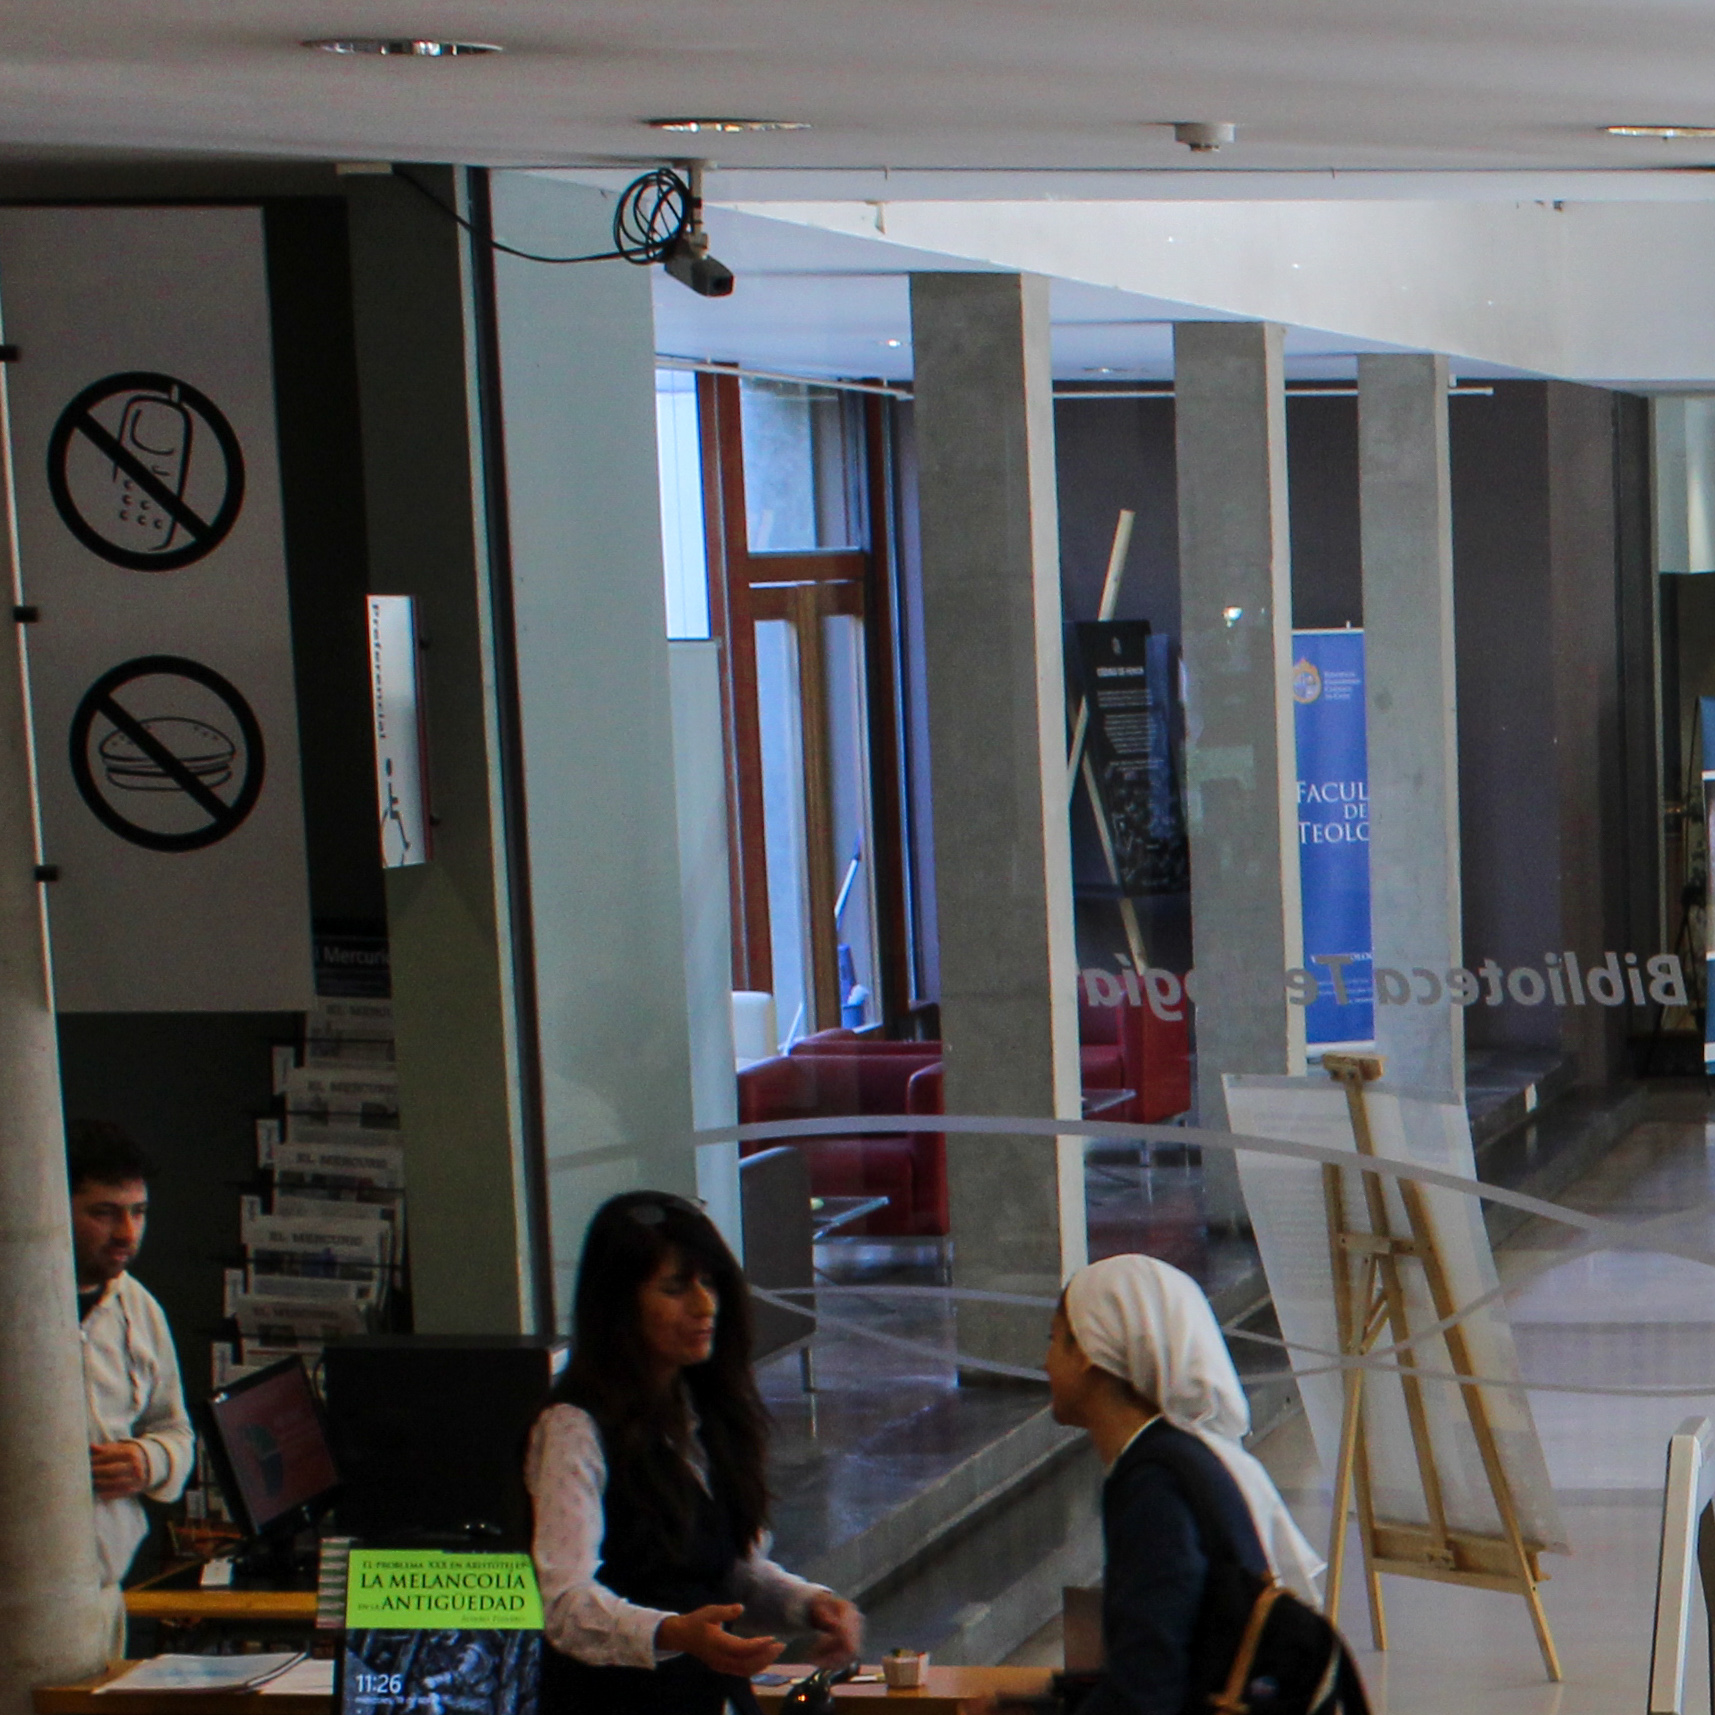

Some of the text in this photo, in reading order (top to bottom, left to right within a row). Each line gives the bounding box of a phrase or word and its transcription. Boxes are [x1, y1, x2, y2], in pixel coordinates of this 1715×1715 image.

[361, 1570, 527, 1589] LA MELANCOLÍA
[382, 1592, 526, 1611] ANTIGÜEDAD
[355, 1673, 404, 1694] 11:26
